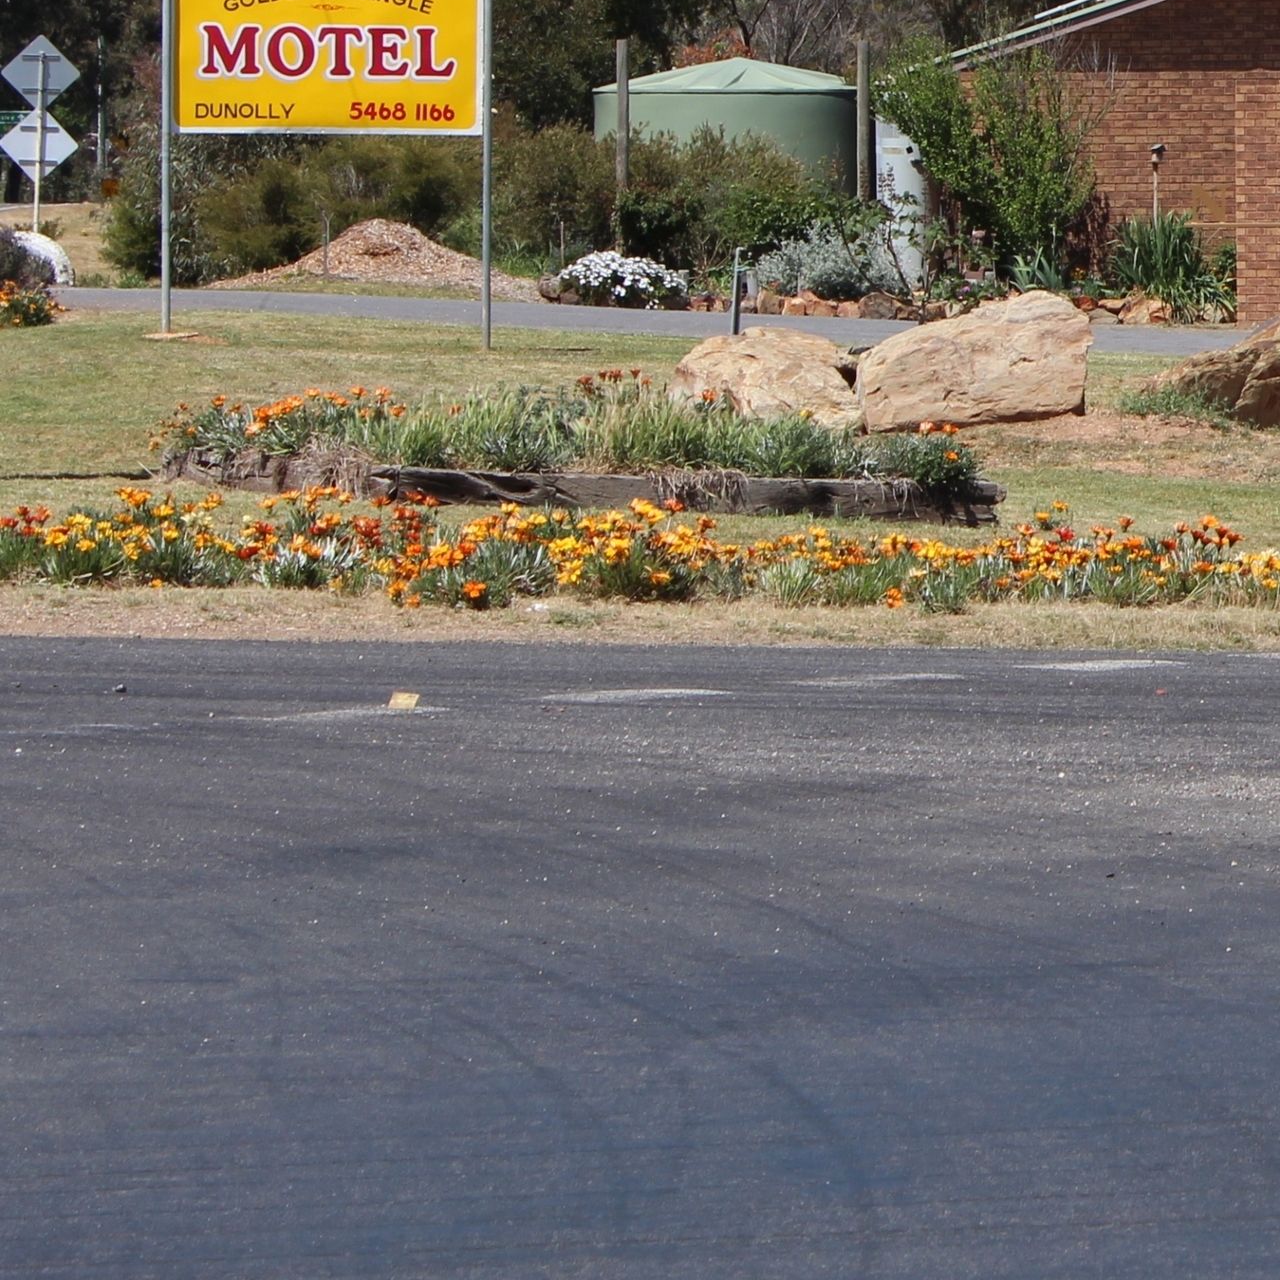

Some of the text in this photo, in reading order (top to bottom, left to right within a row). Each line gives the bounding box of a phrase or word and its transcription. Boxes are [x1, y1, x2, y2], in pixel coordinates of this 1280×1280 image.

[200, 23, 456, 78] MOTEL
[194, 101, 456, 122] DUNOLLY 5468 1166
